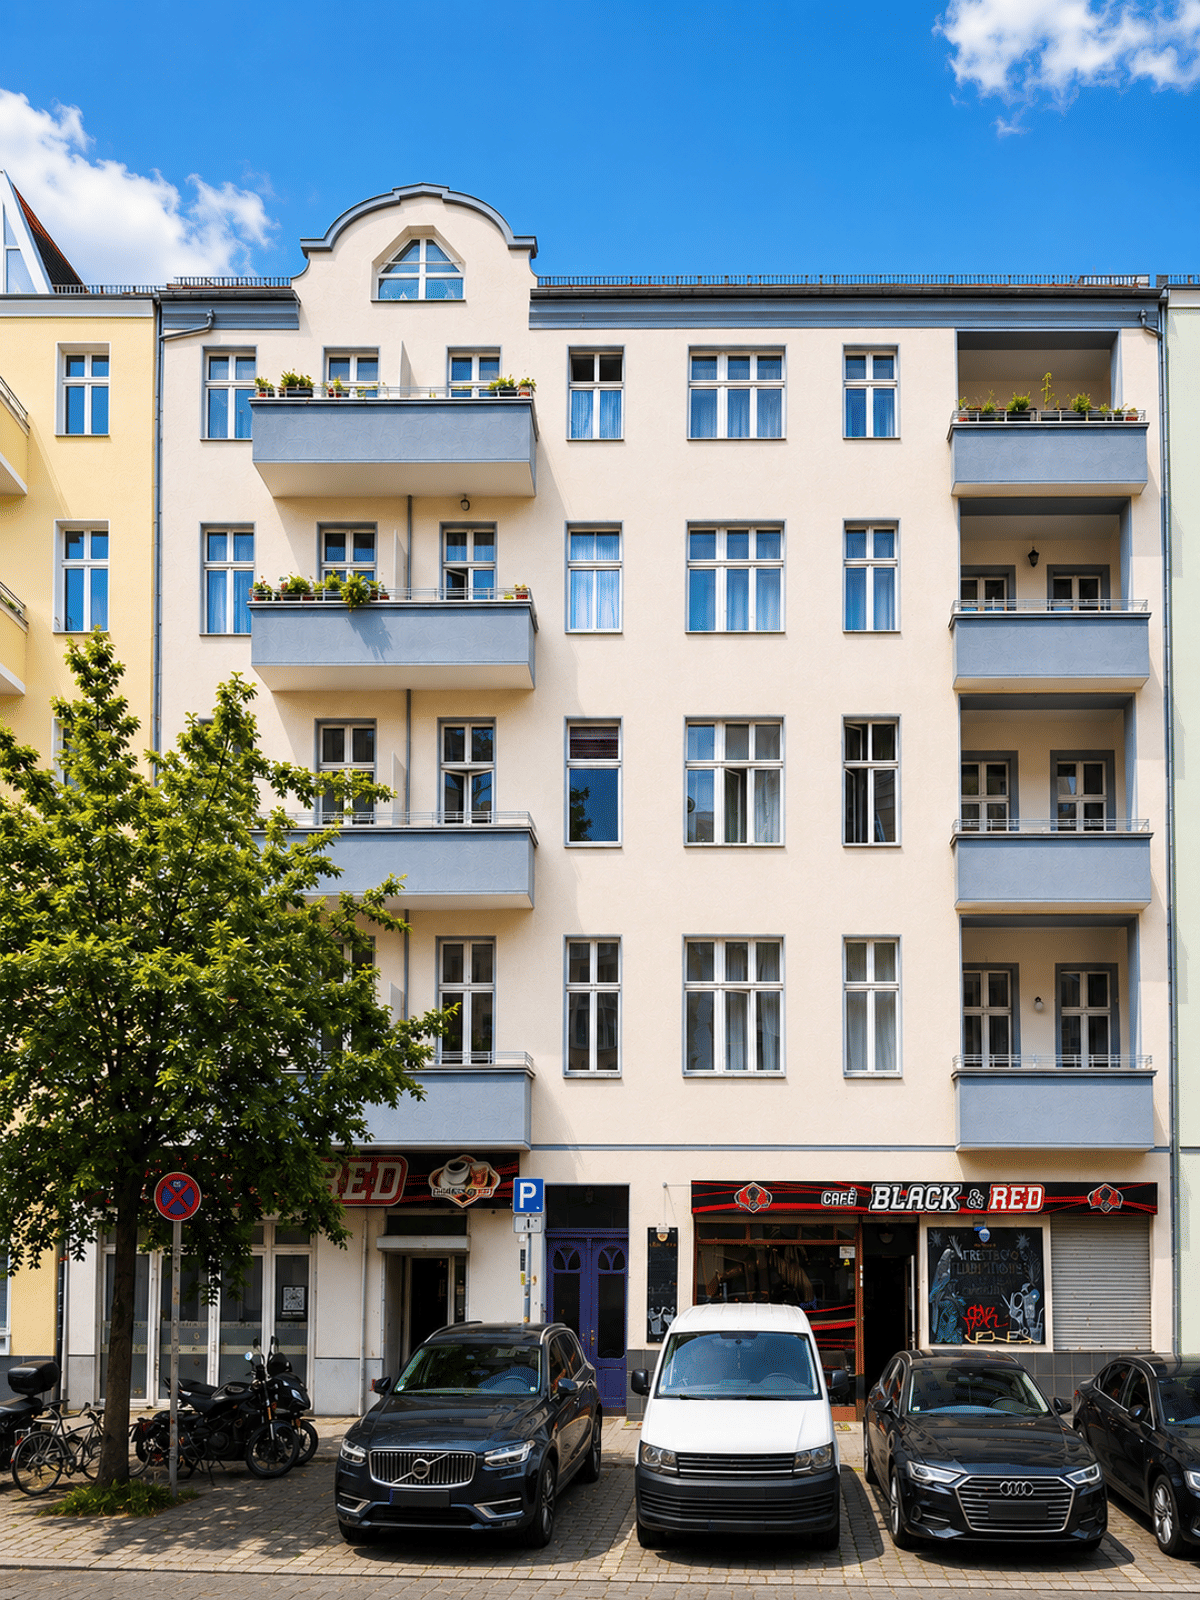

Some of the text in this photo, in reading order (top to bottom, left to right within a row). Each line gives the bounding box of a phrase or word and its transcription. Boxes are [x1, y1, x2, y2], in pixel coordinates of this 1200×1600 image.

[519, 1182, 537, 1209] P
[870, 1185, 961, 1210] BLACK
[967, 1189, 984, 1208] &
[987, 1185, 1044, 1210] RED
